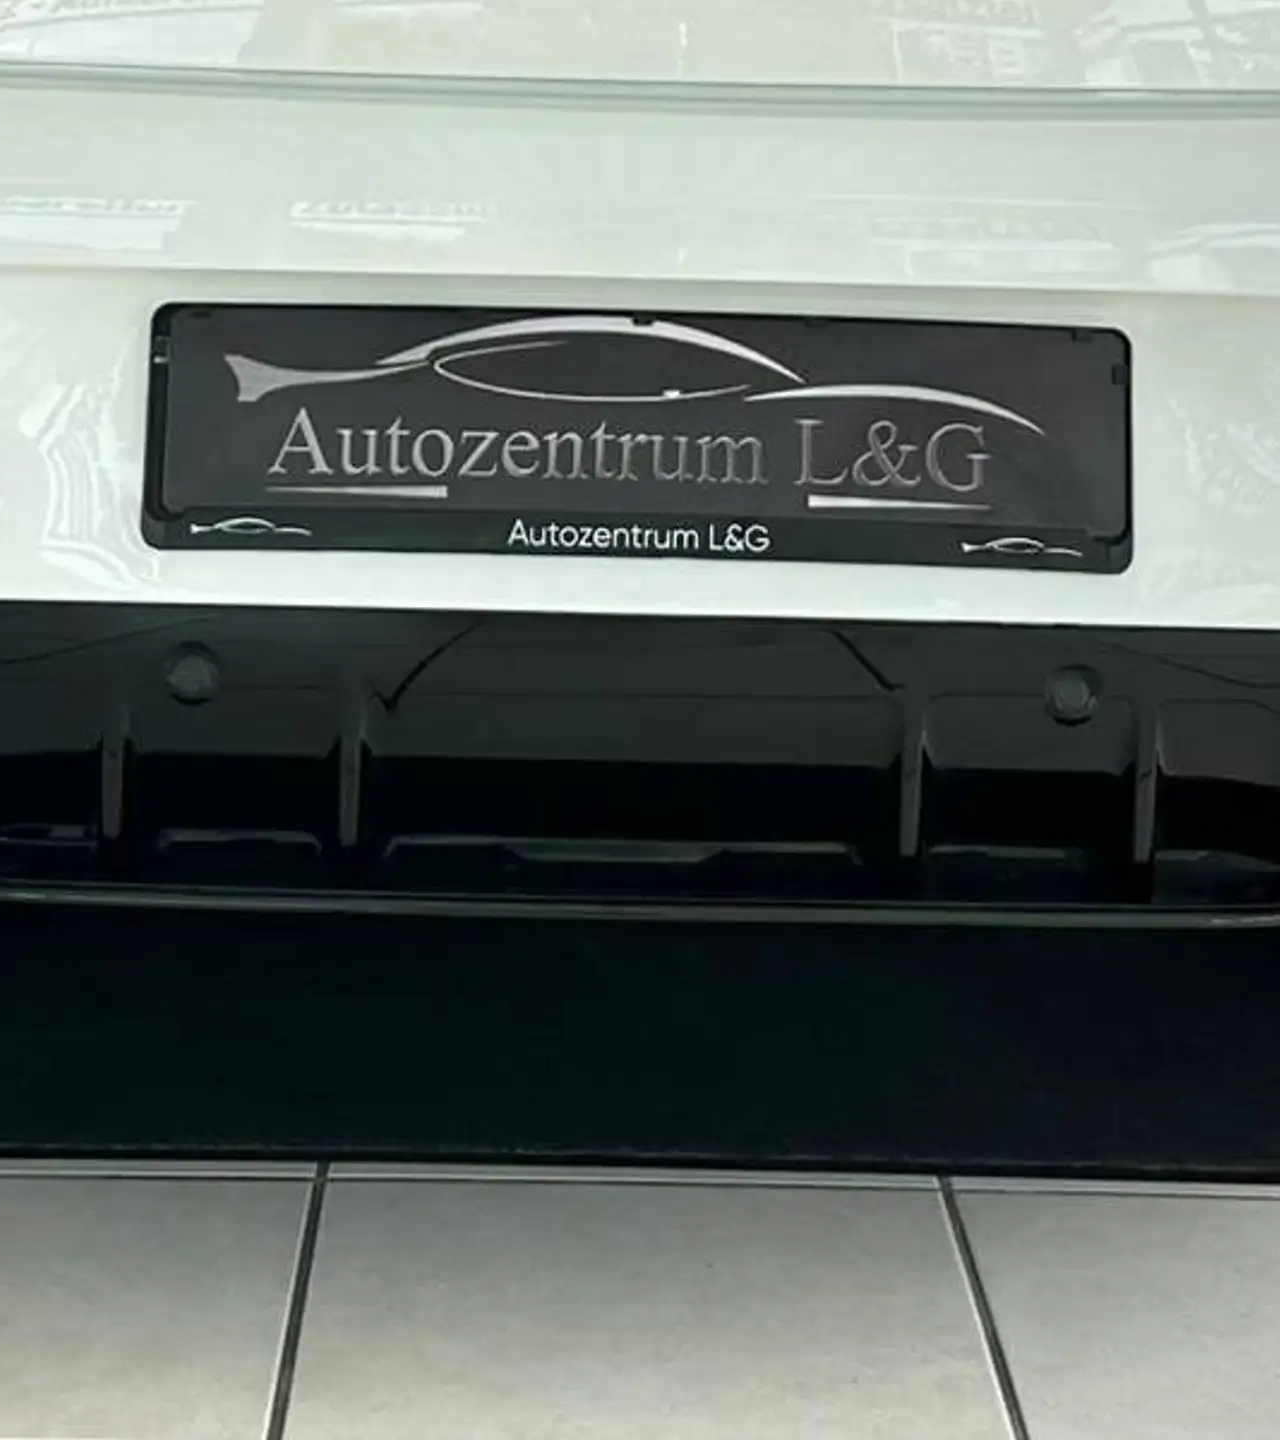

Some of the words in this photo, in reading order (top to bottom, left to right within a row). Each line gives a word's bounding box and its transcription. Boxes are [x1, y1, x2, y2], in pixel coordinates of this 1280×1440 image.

[267, 406, 768, 485] Autozentrum
[793, 419, 992, 492] L&G
[508, 518, 700, 550] Autozentrum
[709, 523, 770, 552] L&G
